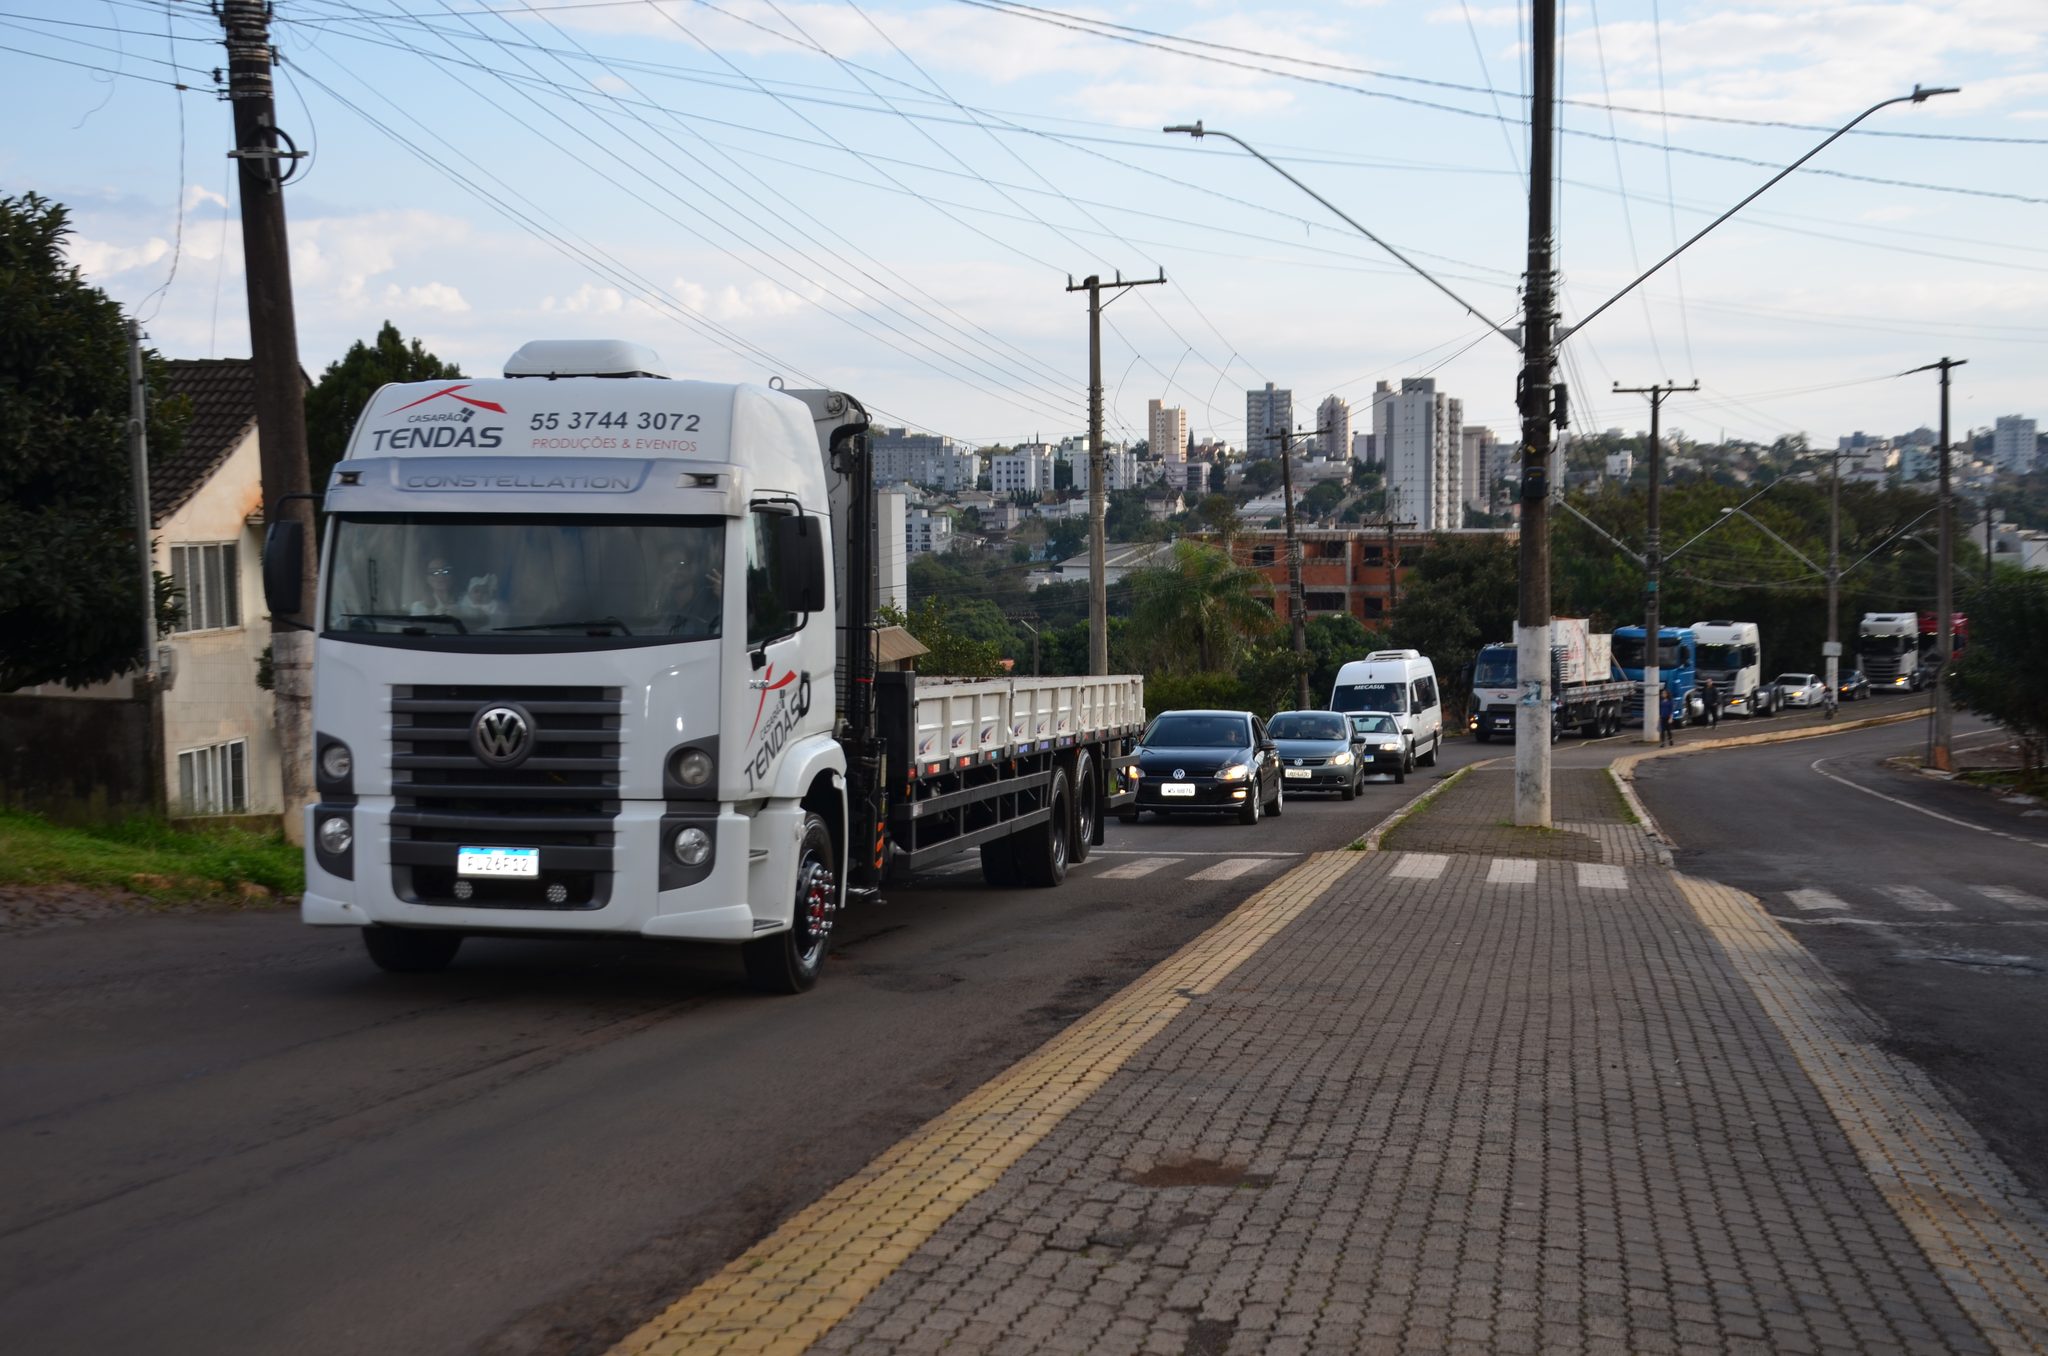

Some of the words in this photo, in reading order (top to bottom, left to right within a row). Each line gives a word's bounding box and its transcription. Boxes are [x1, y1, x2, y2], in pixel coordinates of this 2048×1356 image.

[408, 412, 464, 423] CASARÃO
[530, 412, 560, 431] 55
[568, 411, 628, 430] 3744
[637, 411, 701, 433] 3072
[373, 426, 504, 451] TENDAS
[532, 436, 617, 452] PRODUÇÕES
[622, 438, 631, 449] &
[636, 438, 697, 453] EVENTOS
[407, 475, 632, 490] CONSTELLATION
